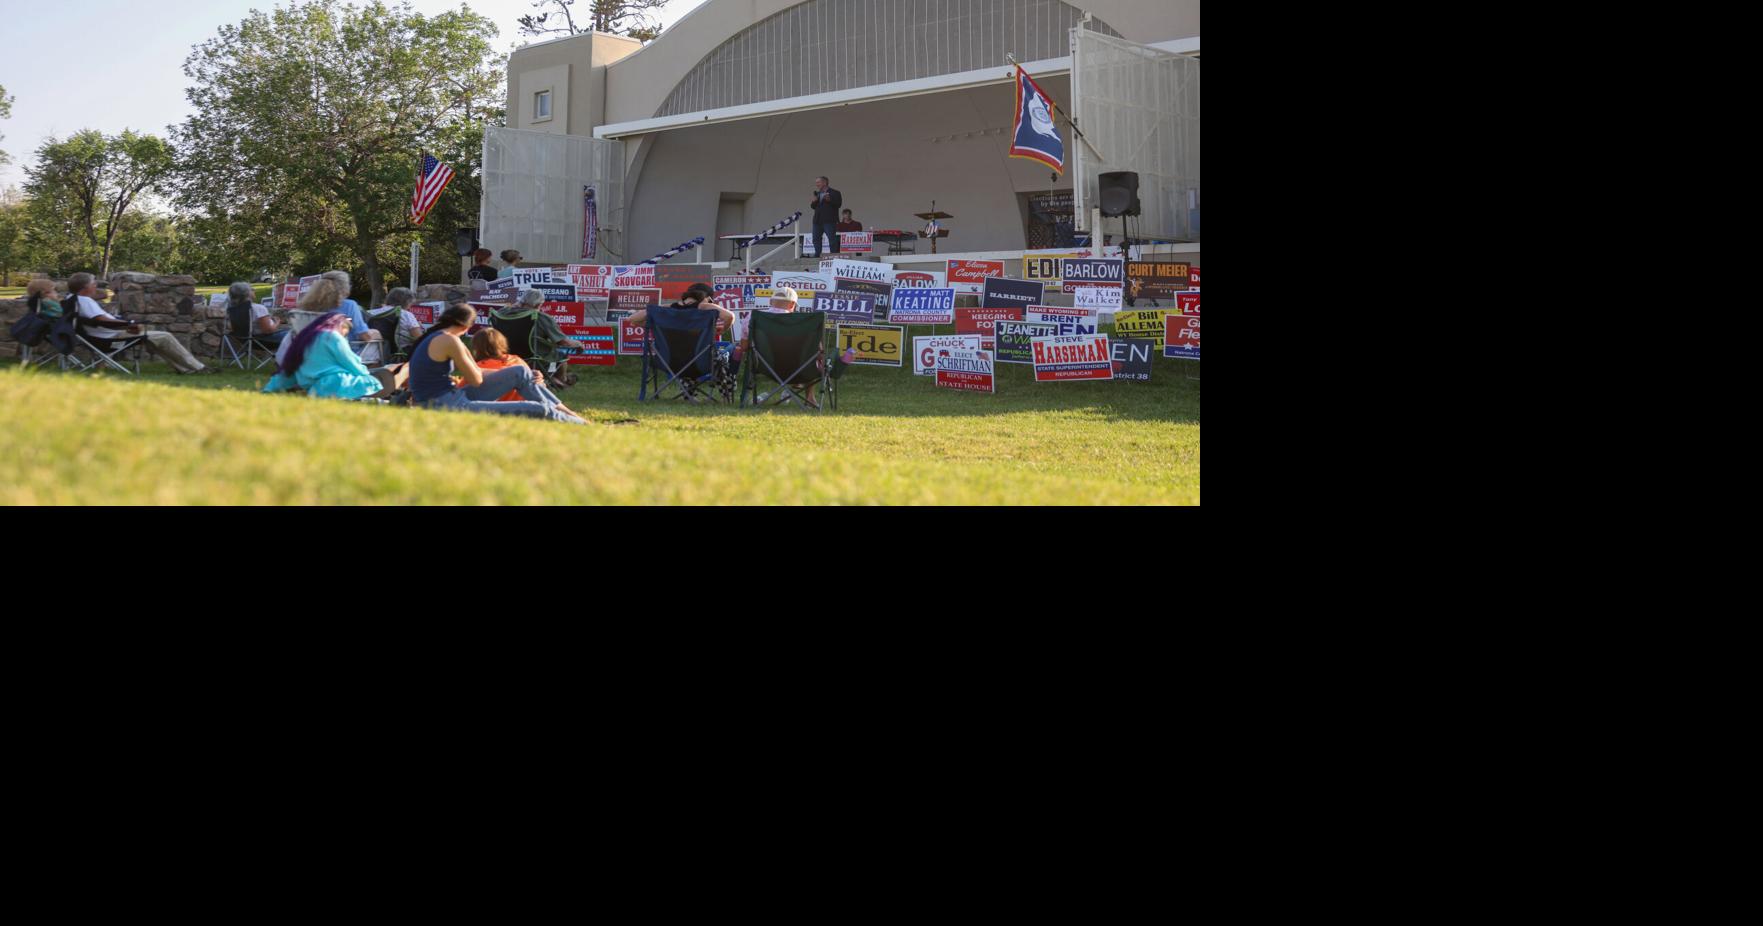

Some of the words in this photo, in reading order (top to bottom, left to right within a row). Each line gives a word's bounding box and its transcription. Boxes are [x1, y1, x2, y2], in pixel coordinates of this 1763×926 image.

[635, 267, 656, 275] JIMM
[955, 269, 999, 279] Campbell
[1065, 264, 1120, 278] BARLOW
[1128, 263, 1154, 277] CURT
[1157, 263, 1187, 277] MEIER
[514, 272, 551, 285] TRUE
[572, 274, 608, 288] WASHUT
[775, 280, 828, 290] COSTELLO
[543, 288, 570, 296] RESANO
[929, 290, 951, 298] MATT
[989, 292, 1036, 302] HARRIET!
[1096, 289, 1121, 297] Kim
[617, 295, 650, 303] HELLING
[895, 296, 951, 309] KEATING
[1077, 296, 1121, 304] Walker
[816, 297, 873, 313] BELL
[553, 315, 577, 323] GGINS
[1041, 315, 1083, 324] BRENT
[1138, 311, 1159, 320] Bill
[626, 327, 645, 336] BO
[998, 322, 1055, 336] JEANETTE
[1117, 321, 1165, 332] ALLEMA
[930, 339, 966, 348] CHUCK
[1054, 335, 1083, 343] STEVE
[581, 340, 601, 350] iatt
[842, 335, 898, 354] Ide
[1032, 338, 1109, 365] HARSHMAN
[1110, 342, 1150, 363] EN
[920, 347, 936, 368] G
[937, 356, 992, 373] SCHRIFTMAN
[1056, 363, 1109, 371] SUPERINTENDENT
[946, 372, 983, 381] REPUBLICAN
[964, 382, 992, 390] HOUSE
